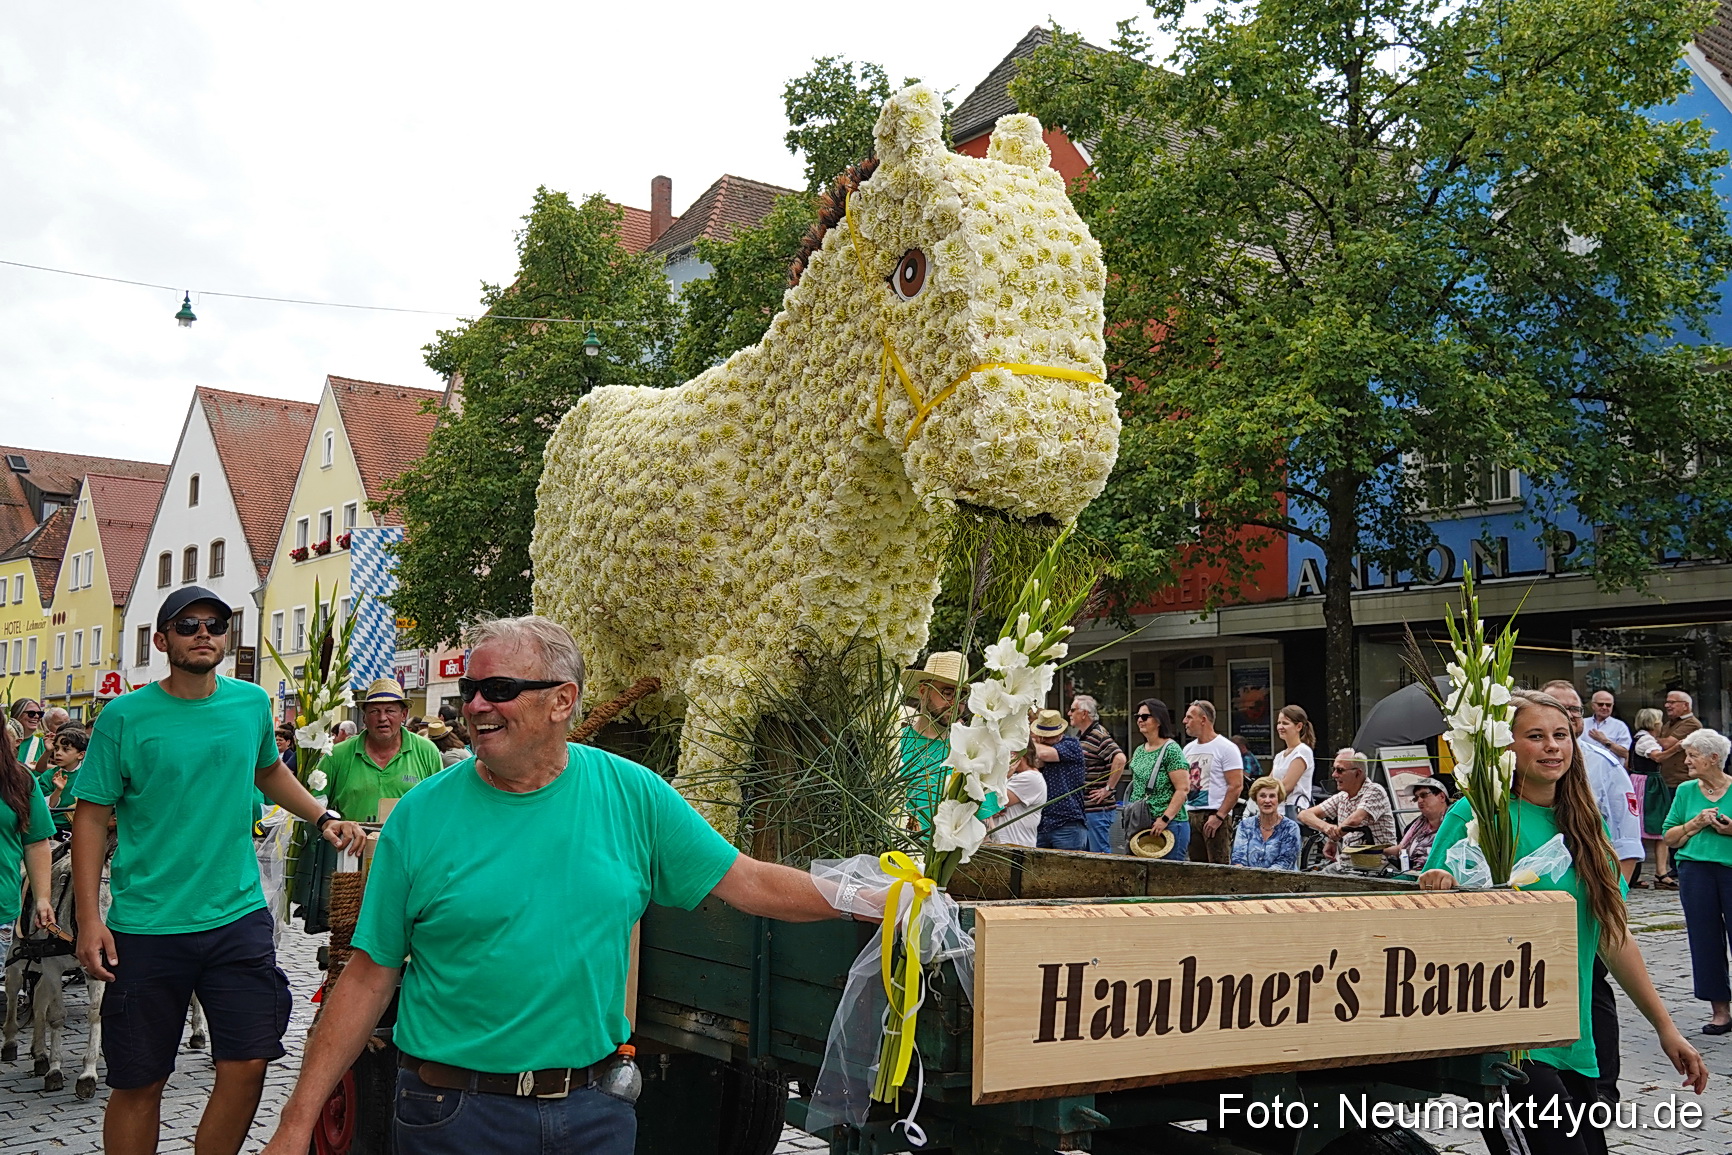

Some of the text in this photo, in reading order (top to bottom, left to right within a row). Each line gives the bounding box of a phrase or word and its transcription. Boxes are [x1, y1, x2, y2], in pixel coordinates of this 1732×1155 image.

[4, 621, 21, 635] HOTEL
[1032, 941, 1548, 1043] Haubner's Ranch
